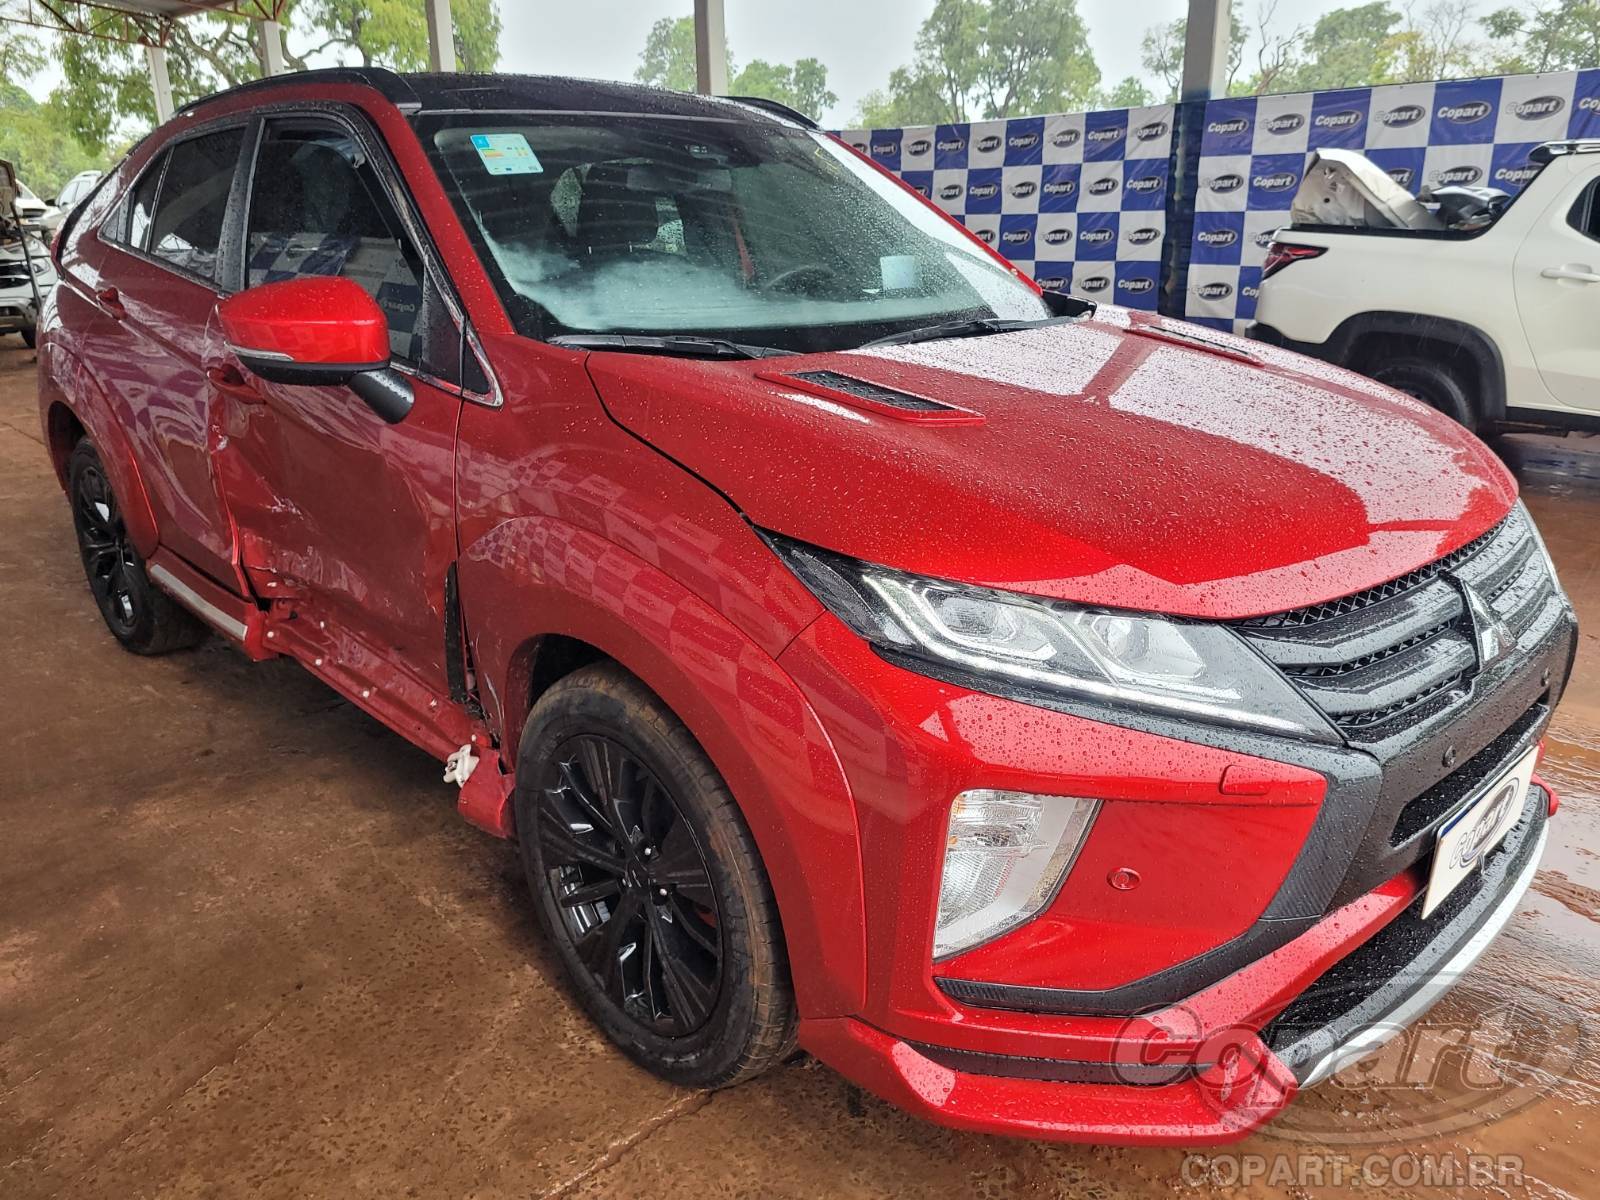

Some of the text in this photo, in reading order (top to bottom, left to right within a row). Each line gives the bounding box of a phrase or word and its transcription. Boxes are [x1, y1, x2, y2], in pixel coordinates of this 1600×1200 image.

[1437, 103, 1486, 119] Copart
[1315, 111, 1356, 127] Copart
[1207, 120, 1245, 134] Copart
[1008, 135, 1035, 148] Copart
[1088, 128, 1119, 142] Copart
[872, 144, 895, 156] Copart
[937, 139, 963, 152] Copart
[1494, 167, 1540, 183] Copar
[1043, 181, 1071, 195] Copart
[1126, 177, 1160, 192] Copart
[1253, 176, 1293, 189] Copart
[969, 186, 994, 198] Copart
[1002, 231, 1029, 243] Copart
[1079, 230, 1110, 243] Copart
[1197, 231, 1234, 244] Copart
[1117, 279, 1150, 292] Copart
